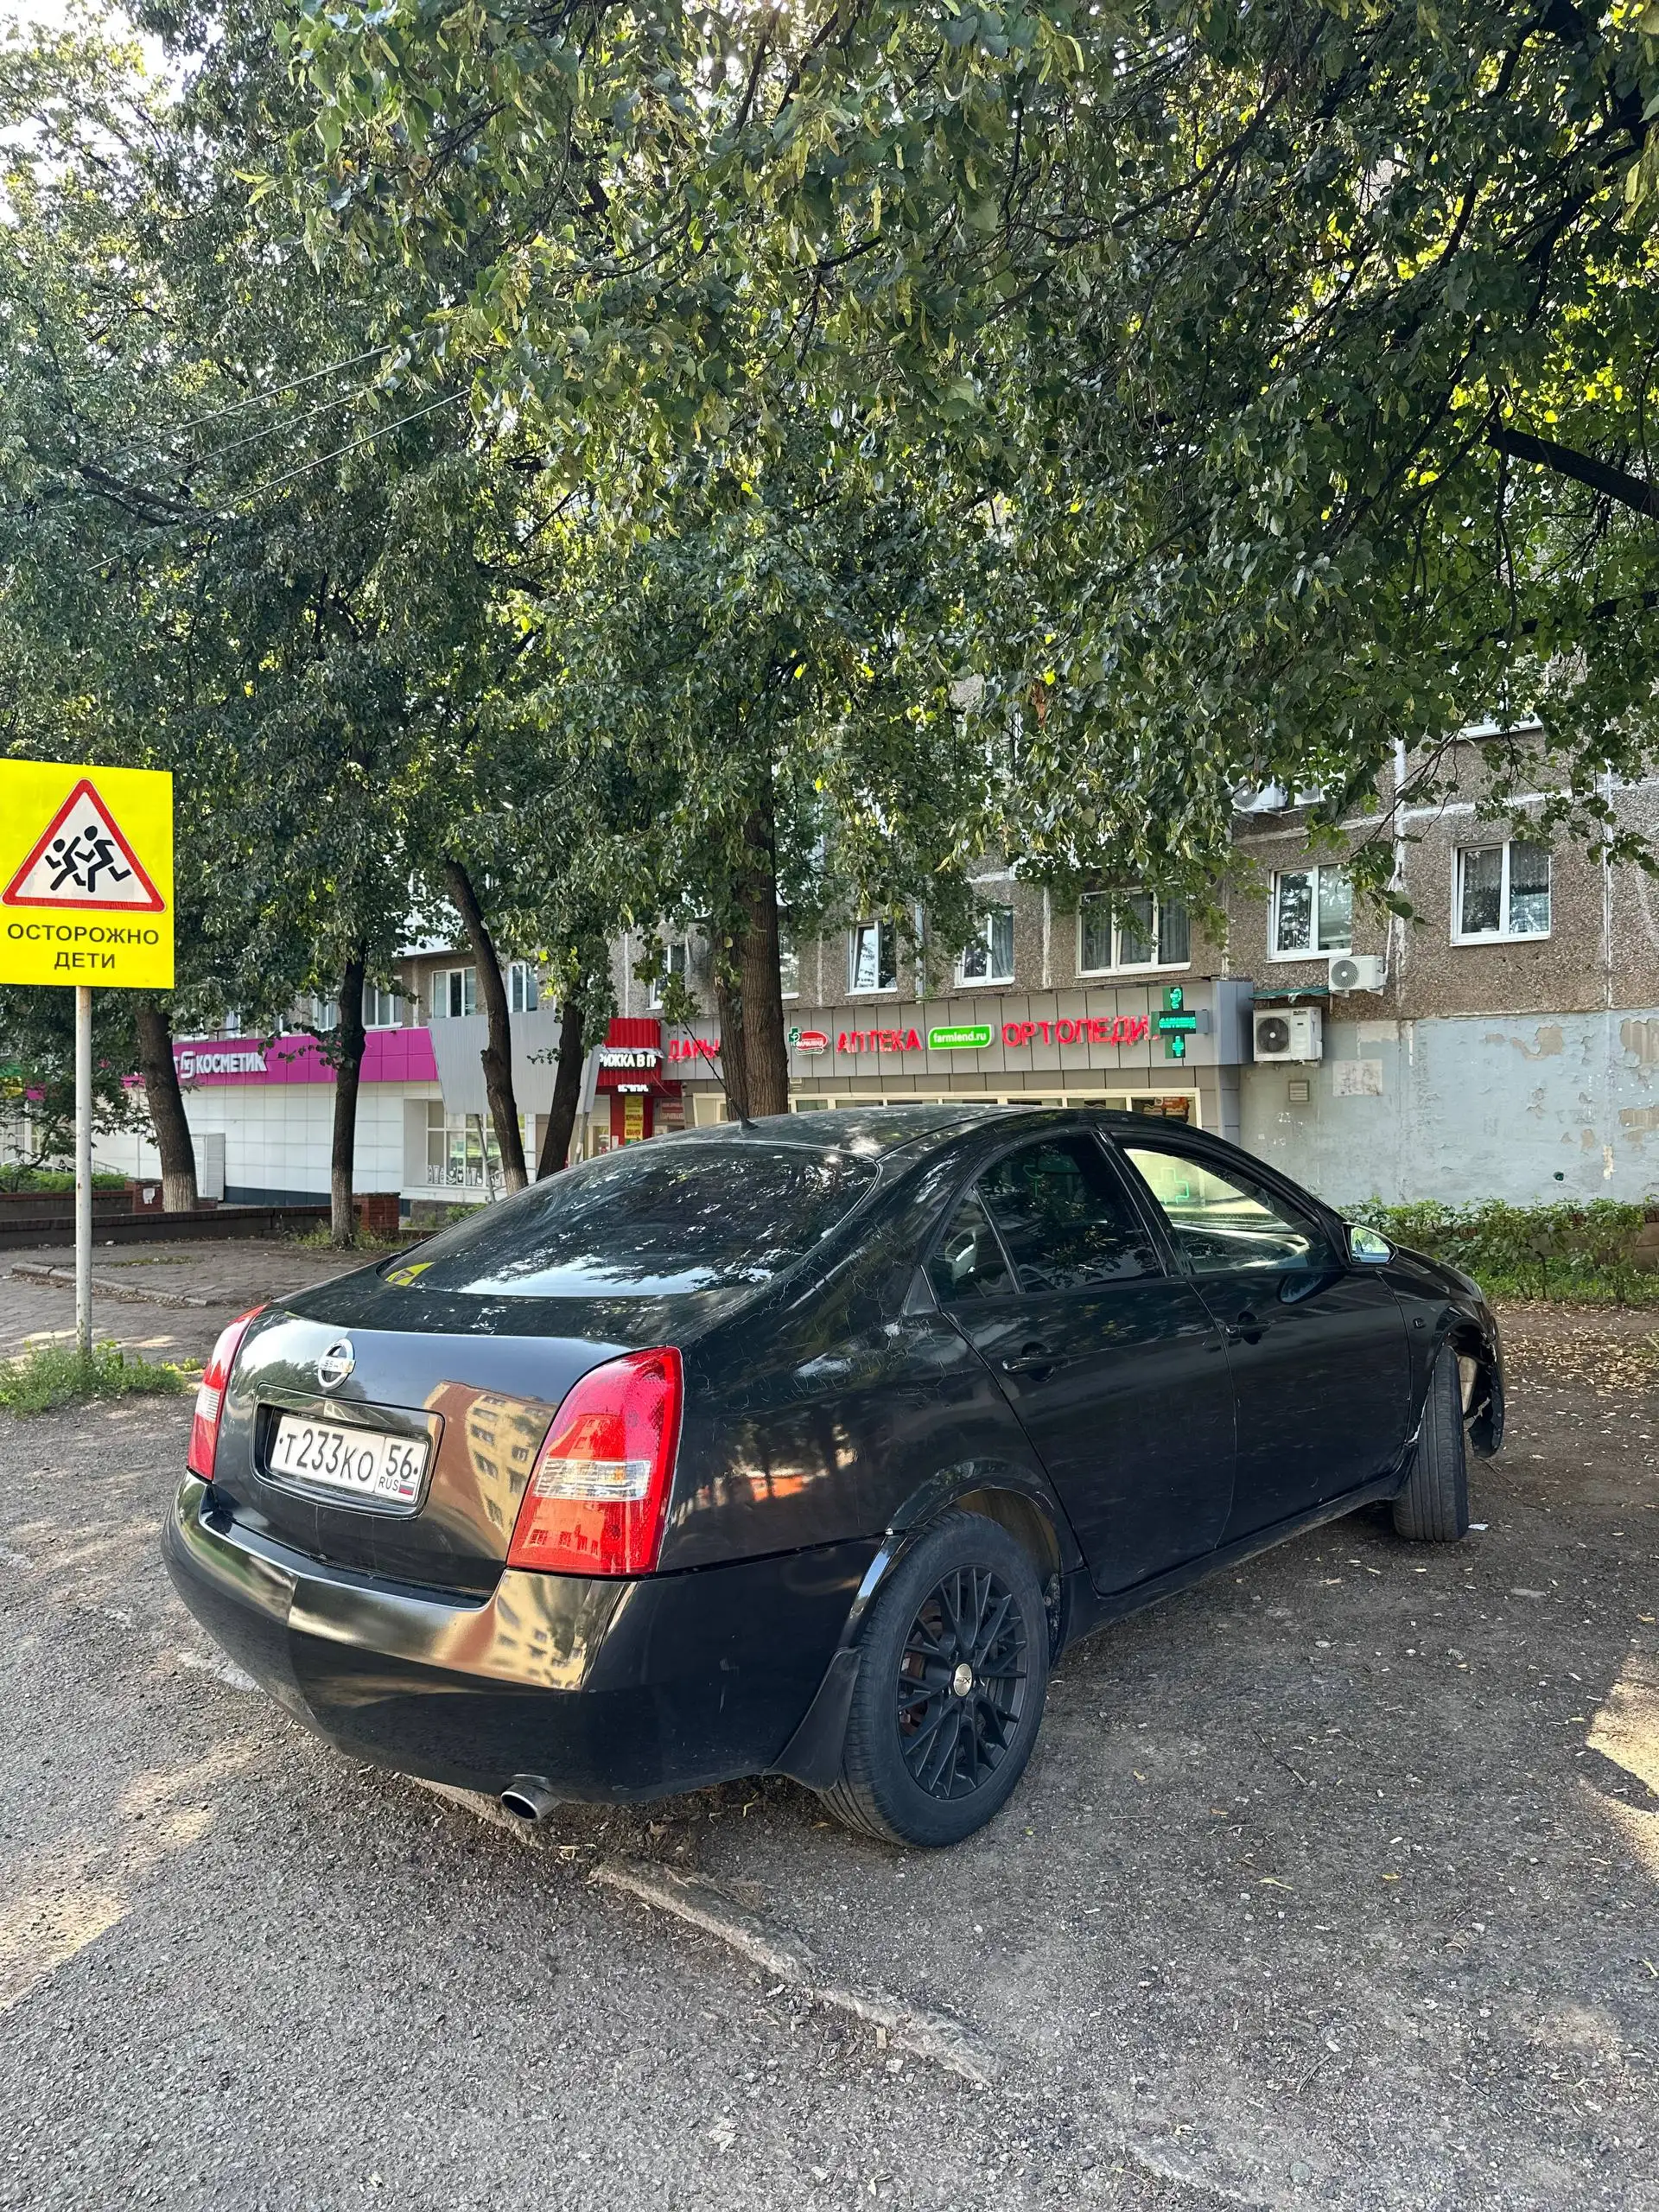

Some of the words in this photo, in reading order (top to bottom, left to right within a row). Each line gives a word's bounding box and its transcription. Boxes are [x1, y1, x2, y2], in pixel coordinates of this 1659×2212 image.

[7, 923, 159, 945] ОСТОРОЖНО
[54, 951, 115, 970] ДЕТИ
[836, 1028, 923, 1053] АПТЕКА
[932, 1029, 987, 1044] farmlend.ru
[1002, 1015, 1160, 1047] ОРТОПЕДИ
[285, 1428, 374, 1482] Т233КО
[385, 1444, 414, 1480] 56
[378, 1476, 399, 1491] RUS
